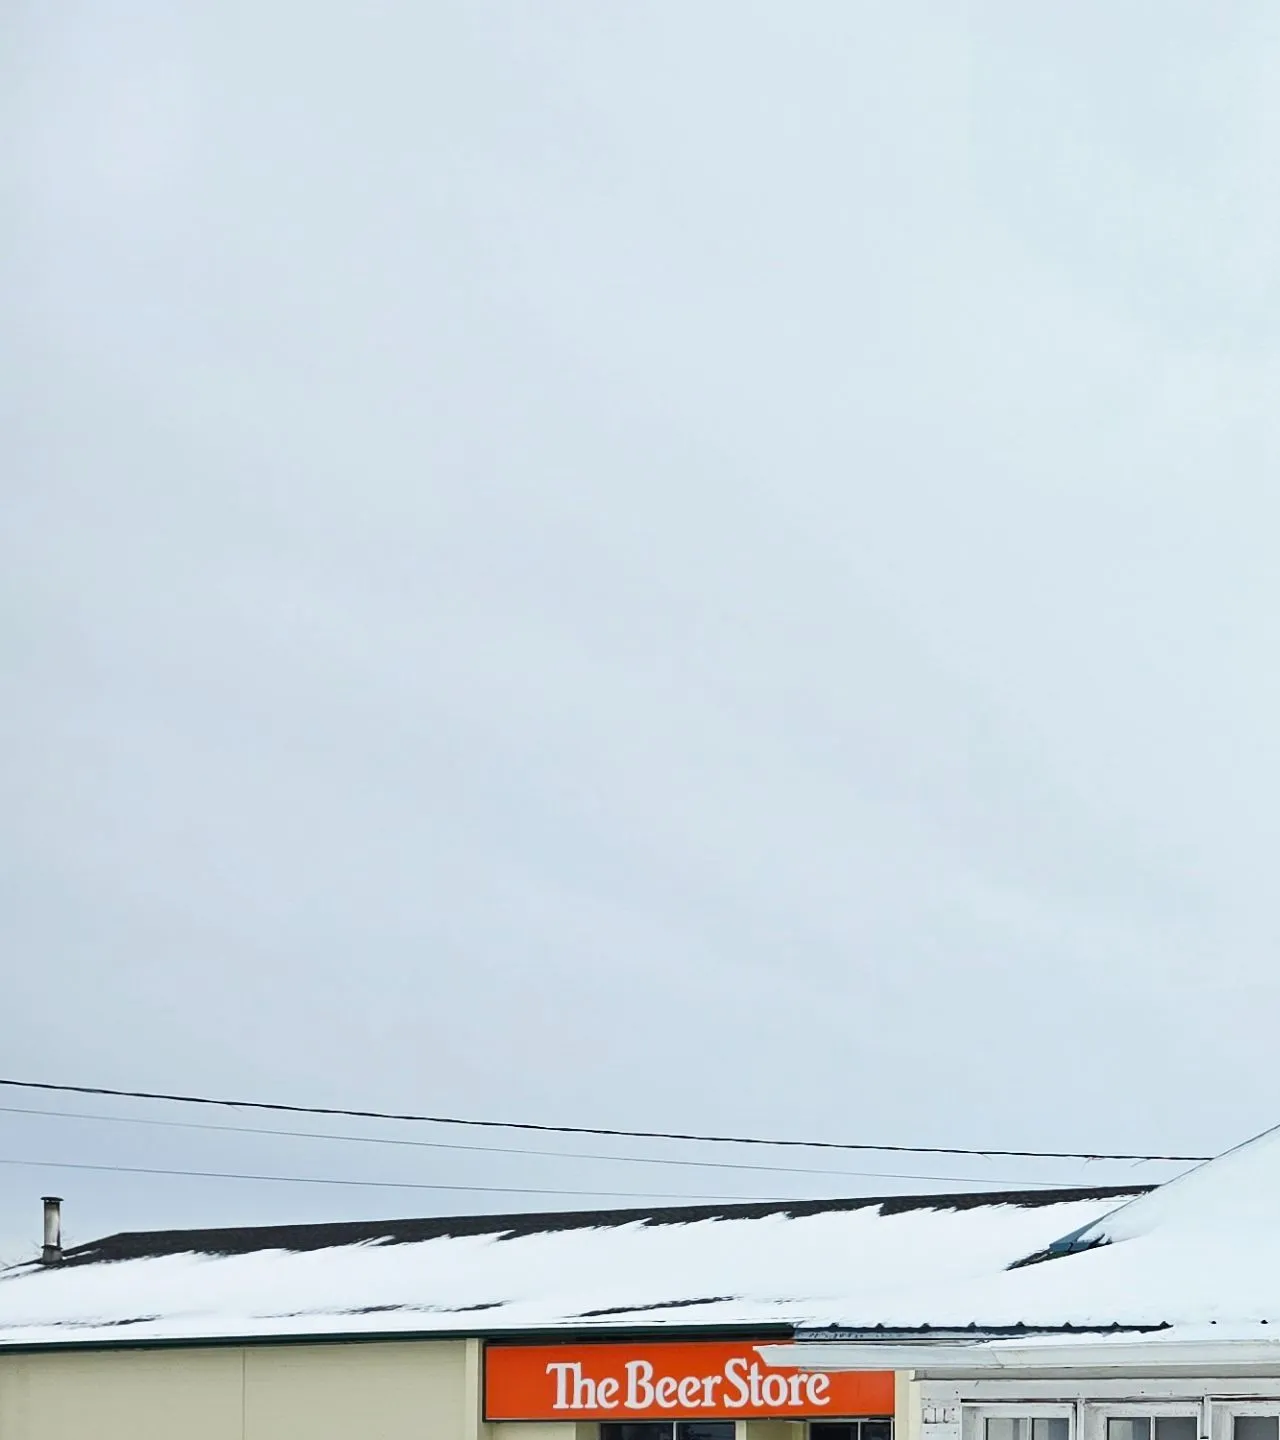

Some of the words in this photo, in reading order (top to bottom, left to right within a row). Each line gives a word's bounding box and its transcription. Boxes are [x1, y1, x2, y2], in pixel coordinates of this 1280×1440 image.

[545, 1361, 620, 1409] The
[624, 1359, 722, 1409] Beer
[723, 1357, 830, 1408] Store
